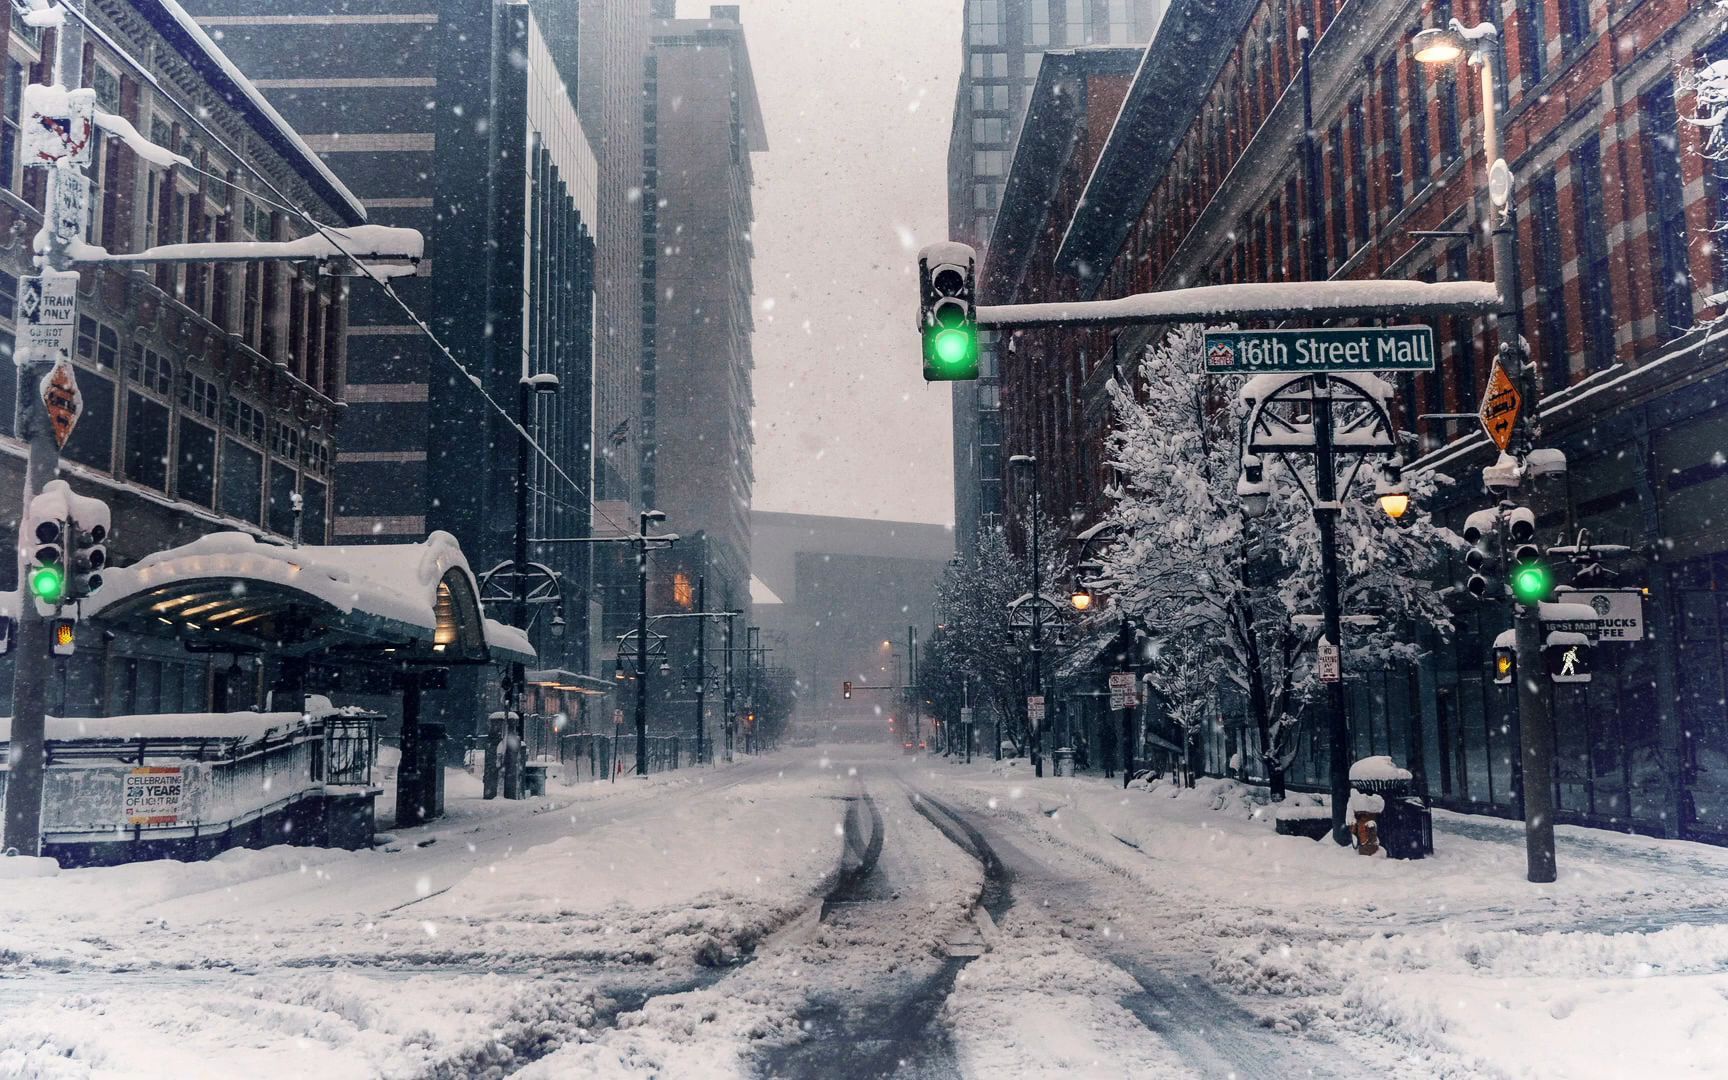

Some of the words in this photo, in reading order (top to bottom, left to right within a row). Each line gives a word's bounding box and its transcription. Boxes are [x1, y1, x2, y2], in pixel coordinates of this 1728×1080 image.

[43, 295, 74, 307] TRAIN
[43, 309, 71, 320] ONLY
[1237, 337, 1288, 365] 16th
[1295, 336, 1371, 364] Street
[1376, 334, 1429, 363] Mall
[1575, 622, 1597, 630] Mall
[1599, 618, 1637, 628] BUCKS
[127, 775, 182, 785] CELEBRATING
[146, 785, 181, 797] YEARS
[126, 798, 140, 806] OF
